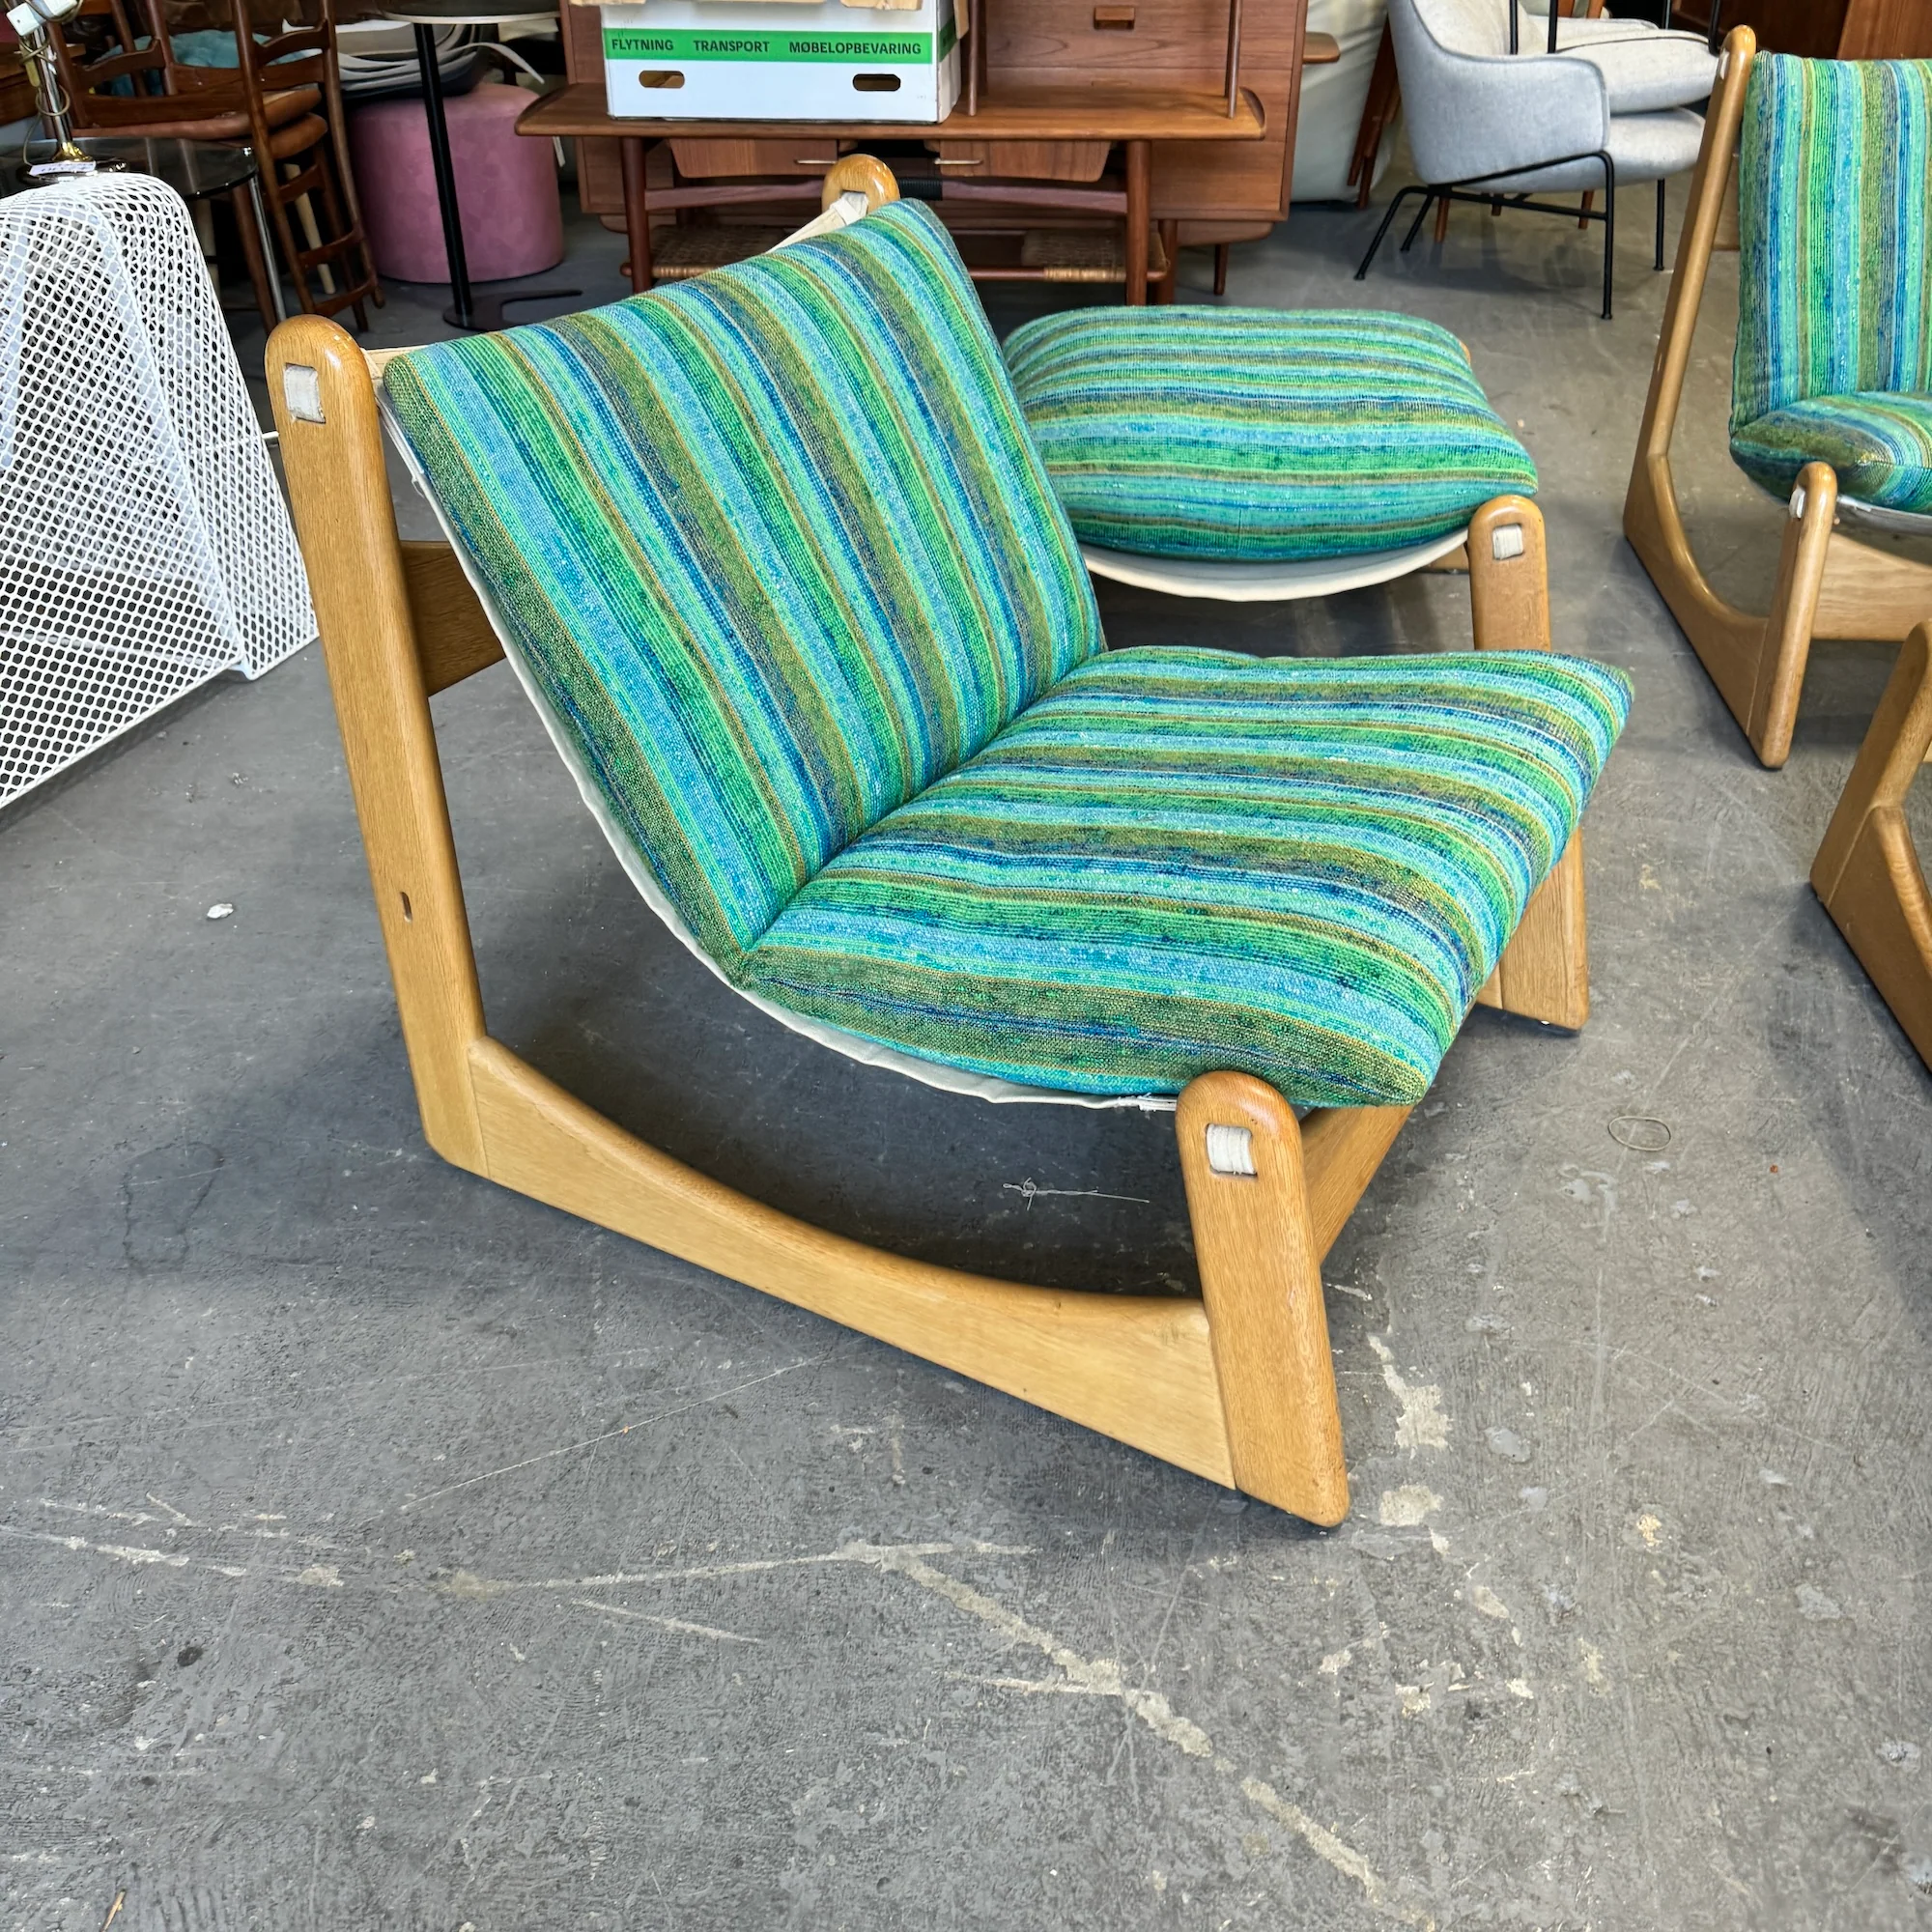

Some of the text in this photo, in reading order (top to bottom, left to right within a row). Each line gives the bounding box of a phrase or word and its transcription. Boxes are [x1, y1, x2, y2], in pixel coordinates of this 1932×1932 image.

[611, 39, 922, 55] FLYTNING TRANSPORT MØBELOPBEVARING
